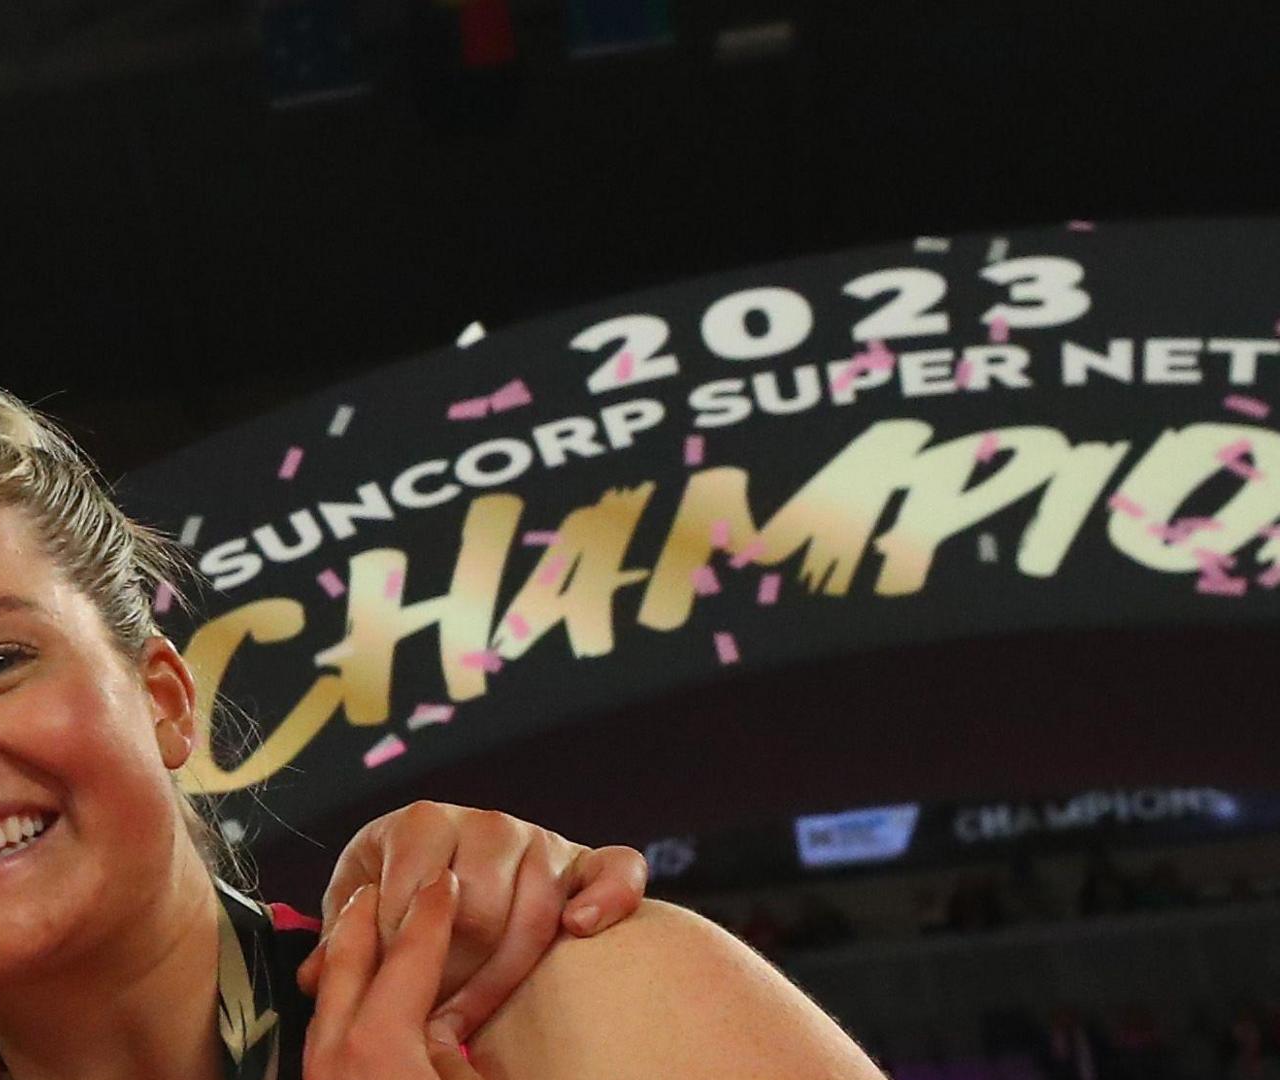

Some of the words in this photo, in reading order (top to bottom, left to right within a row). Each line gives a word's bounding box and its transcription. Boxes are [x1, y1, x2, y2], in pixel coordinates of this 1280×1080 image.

[571, 255, 1092, 394] 2023
[200, 398, 665, 592] SUNCORP
[689, 344, 1032, 429] SUPER
[183, 418, 1280, 796] CHAMPIO
